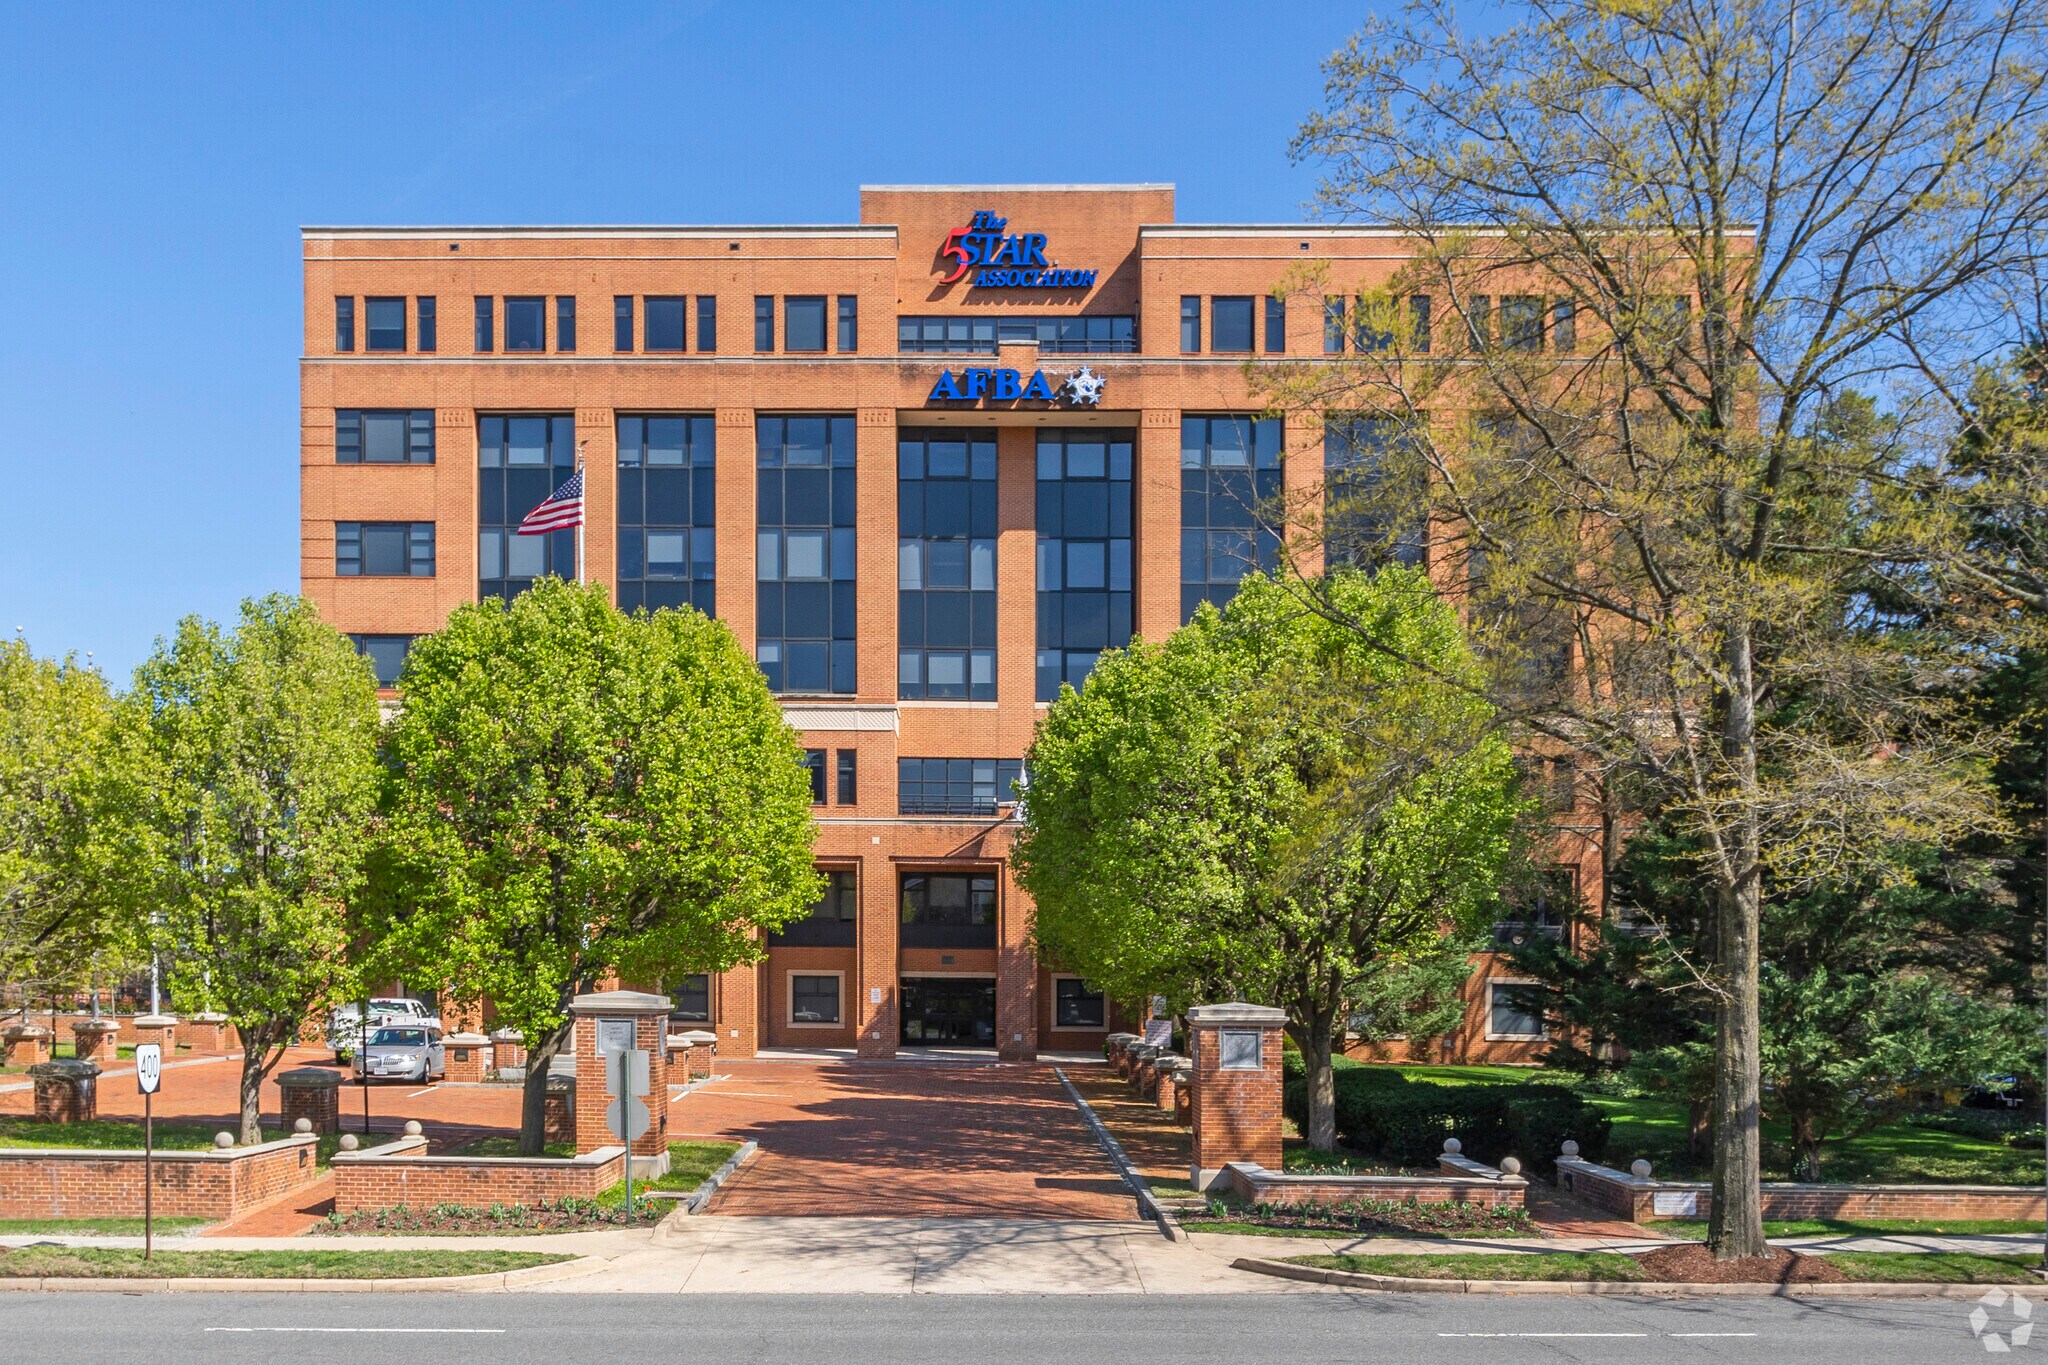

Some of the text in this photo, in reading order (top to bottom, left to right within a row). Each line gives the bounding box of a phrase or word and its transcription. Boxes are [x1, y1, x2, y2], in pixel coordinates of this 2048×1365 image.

[973, 210, 1008, 229] The
[973, 269, 1099, 287] ASSOCIATION
[929, 368, 1057, 399] AFBA
[140, 1054, 158, 1079] 400
